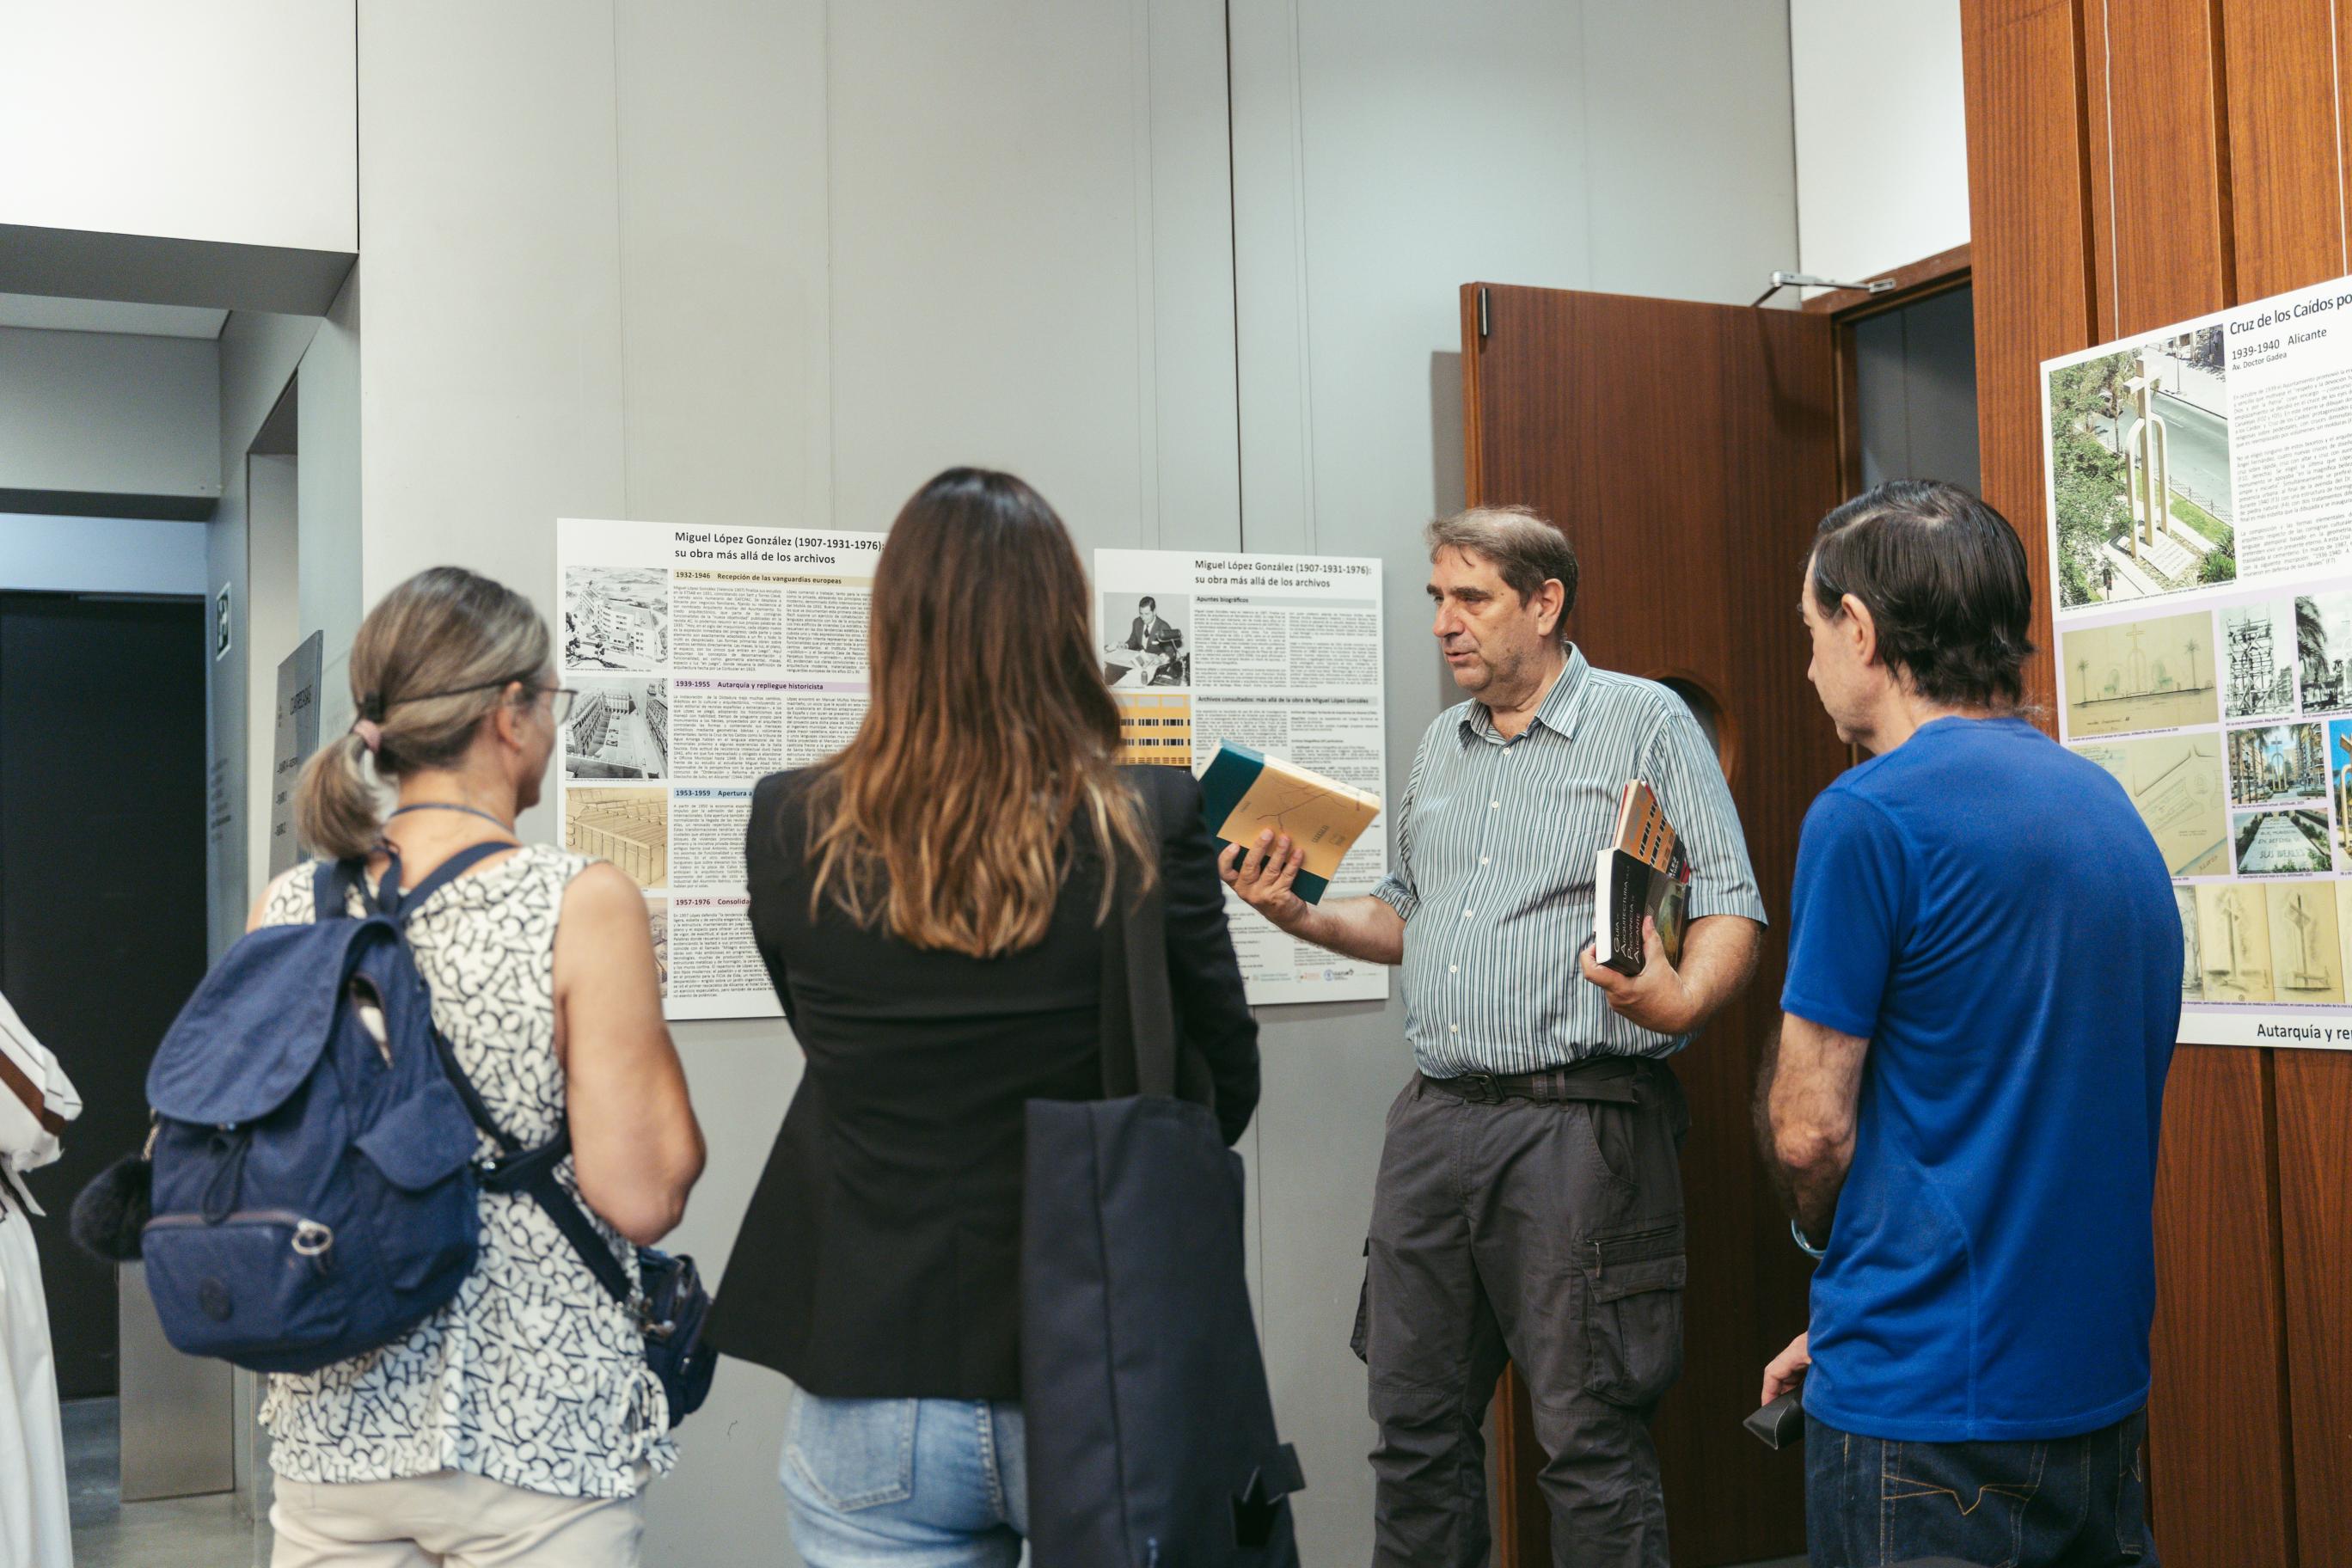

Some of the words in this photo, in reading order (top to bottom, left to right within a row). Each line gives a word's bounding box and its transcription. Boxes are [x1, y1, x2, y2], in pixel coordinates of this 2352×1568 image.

[2230, 322, 2255, 334] Cruz
[2257, 313, 2272, 328] de
[2275, 309, 2291, 323] los
[2294, 298, 2334, 318] Caídos
[2232, 339, 2280, 360] 1939-1940
[2288, 328, 2327, 346] Alicante
[2243, 358, 2264, 369] Doctor
[2266, 352, 2288, 362] Gadea
[675, 533, 711, 543] Miguel
[714, 535, 744, 544] López
[746, 536, 792, 546] González
[689, 548, 714, 558] obra
[716, 550, 738, 559] más
[740, 551, 758, 560] allá
[761, 552, 774, 560] de
[776, 553, 792, 561] los
[793, 554, 836, 563] archivos
[1195, 560, 1226, 570] Miguel
[1228, 562, 1253, 571] López
[1254, 562, 1294, 571] González
[1295, 564, 1371, 574] (1907-1931-1976):
[1280, 578, 1293, 586] los
[2257, 1023, 2321, 1041] Autarquía
[2324, 1029, 2332, 1042] y
[2337, 1029, 2352, 1039] re
